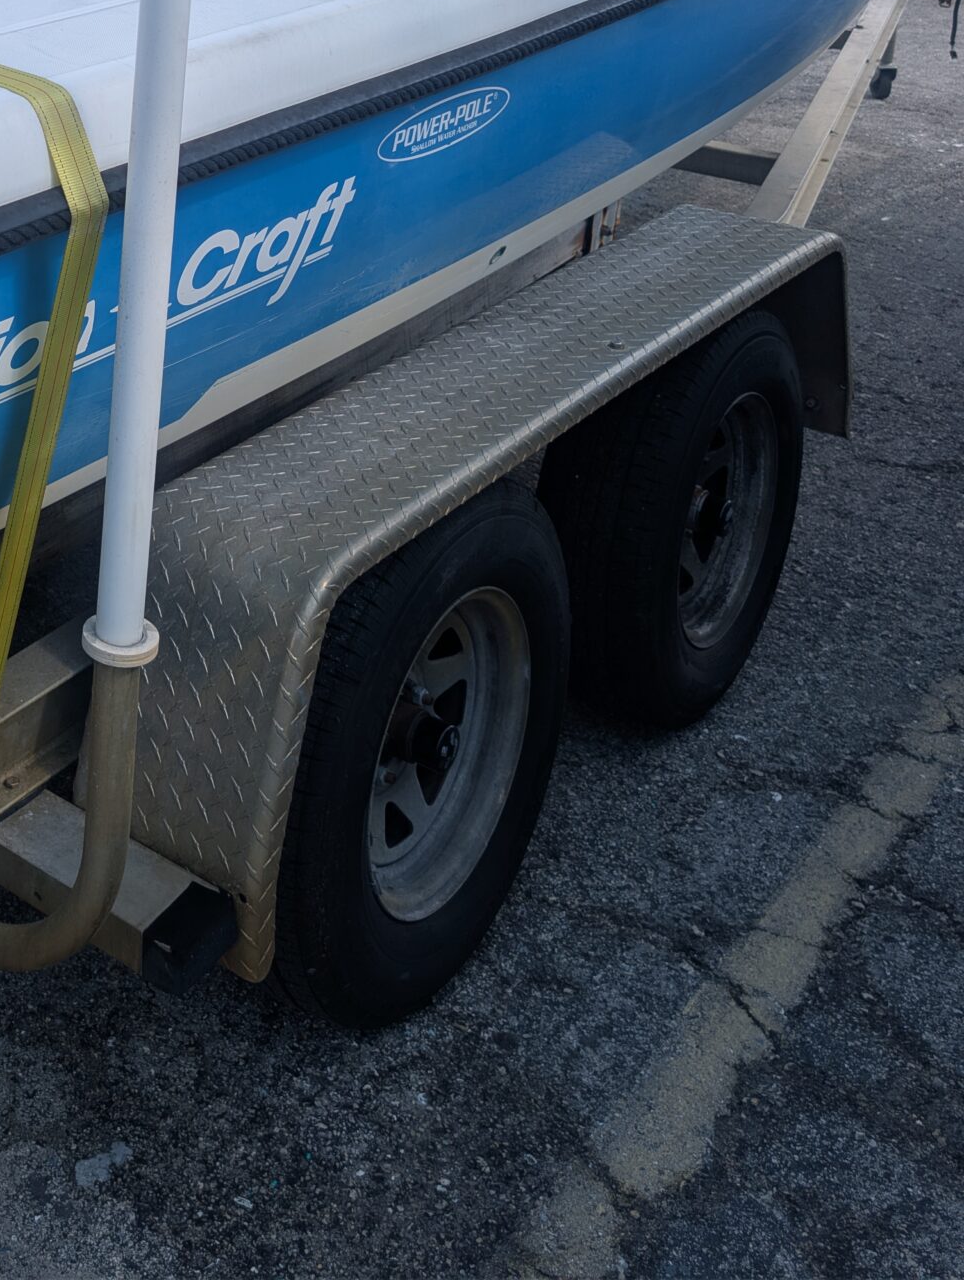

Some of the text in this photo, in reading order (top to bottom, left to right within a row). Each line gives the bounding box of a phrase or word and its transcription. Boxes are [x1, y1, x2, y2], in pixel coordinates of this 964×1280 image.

[392, 92, 494, 153] POWER-POLE
[412, 120, 477, 153] SHALLOW WATER ANCHOR
[176, 175, 356, 307] Craft
